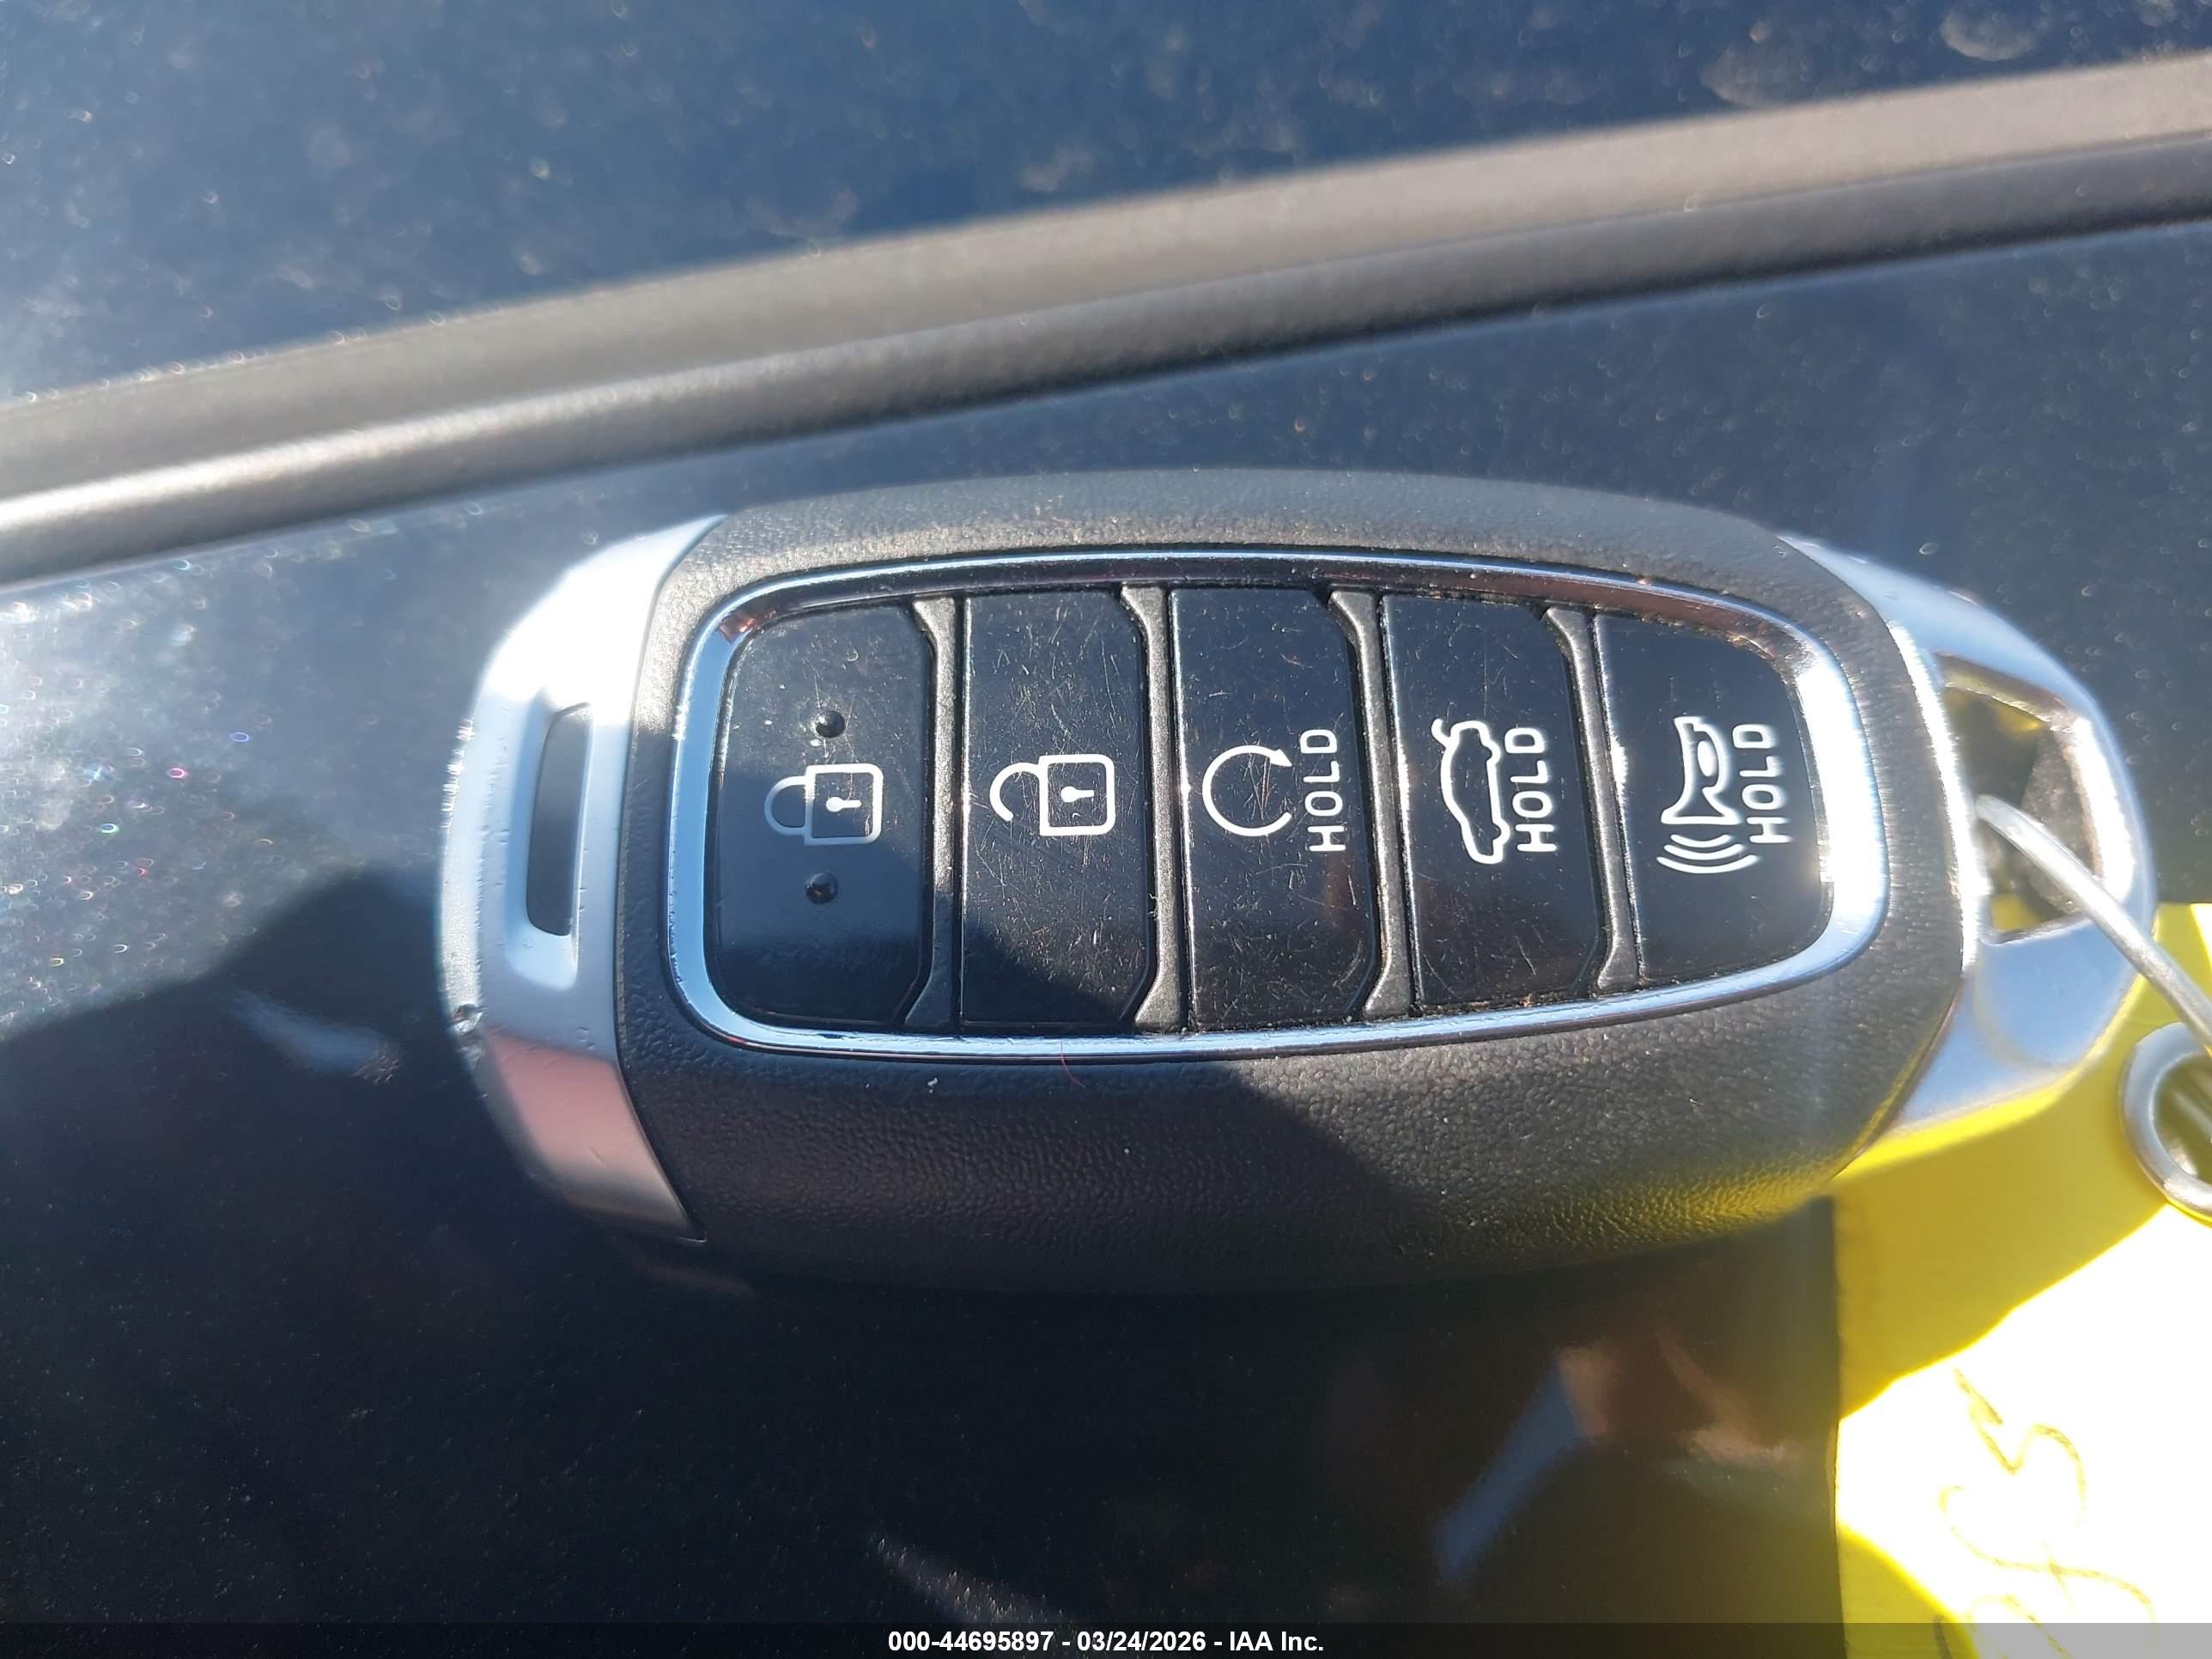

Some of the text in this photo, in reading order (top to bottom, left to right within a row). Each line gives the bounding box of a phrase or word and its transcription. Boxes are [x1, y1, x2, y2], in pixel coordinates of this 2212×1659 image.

[1300, 728, 1346, 852] HOLD
[1504, 726, 1557, 853] HOLD
[1731, 723, 1794, 844] HOLD
